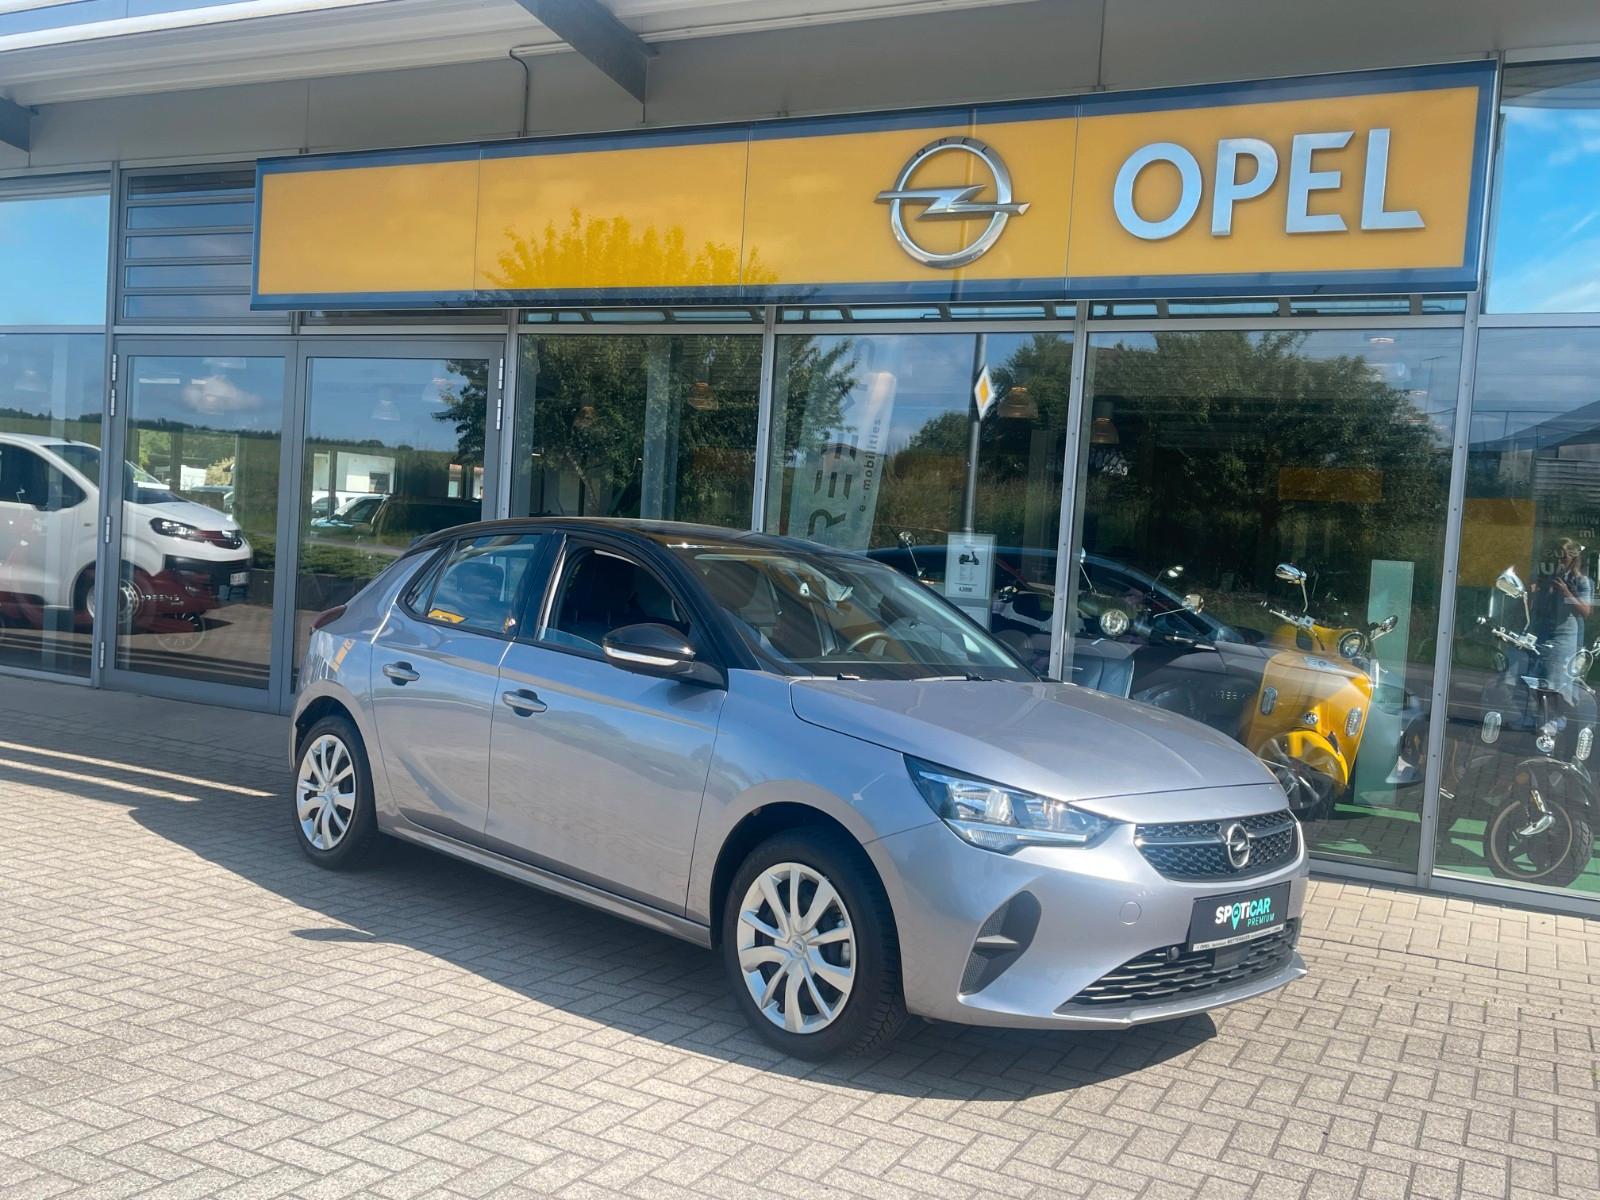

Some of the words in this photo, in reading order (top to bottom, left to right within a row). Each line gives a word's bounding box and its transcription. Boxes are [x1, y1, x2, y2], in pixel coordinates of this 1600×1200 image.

[916, 137, 989, 158] OPEL
[1113, 128, 1426, 241] OPEL
[1247, 912, 1275, 927] PREMIUM
